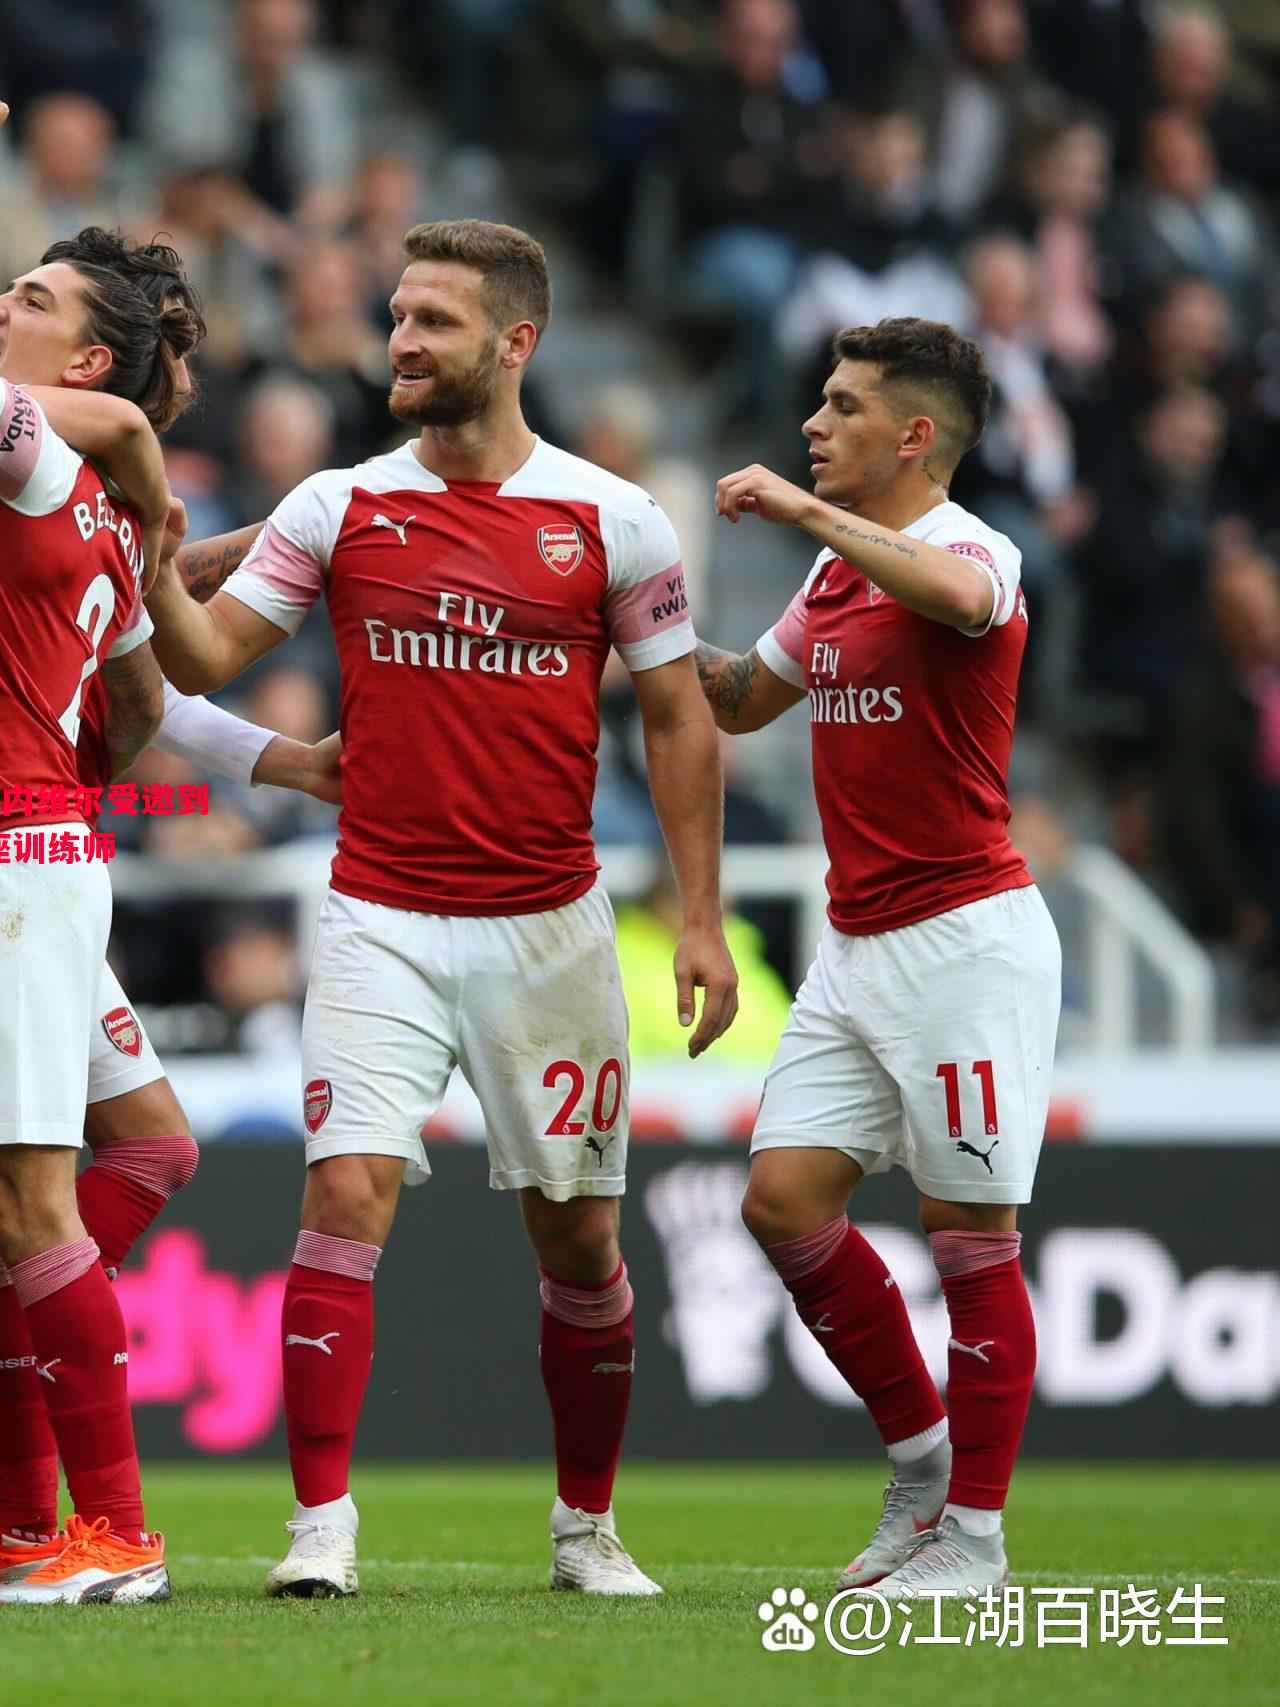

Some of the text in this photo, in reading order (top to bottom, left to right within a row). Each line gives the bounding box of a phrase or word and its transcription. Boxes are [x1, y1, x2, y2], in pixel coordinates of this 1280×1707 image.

[543, 531, 577, 542] Arsenal
[438, 591, 505, 637] Fly
[58, 573, 116, 748] 2
[363, 618, 570, 677] Emirates
[811, 642, 841, 680] Fly
[542, 1057, 623, 1136] 20
[936, 1060, 999, 1138] 11
